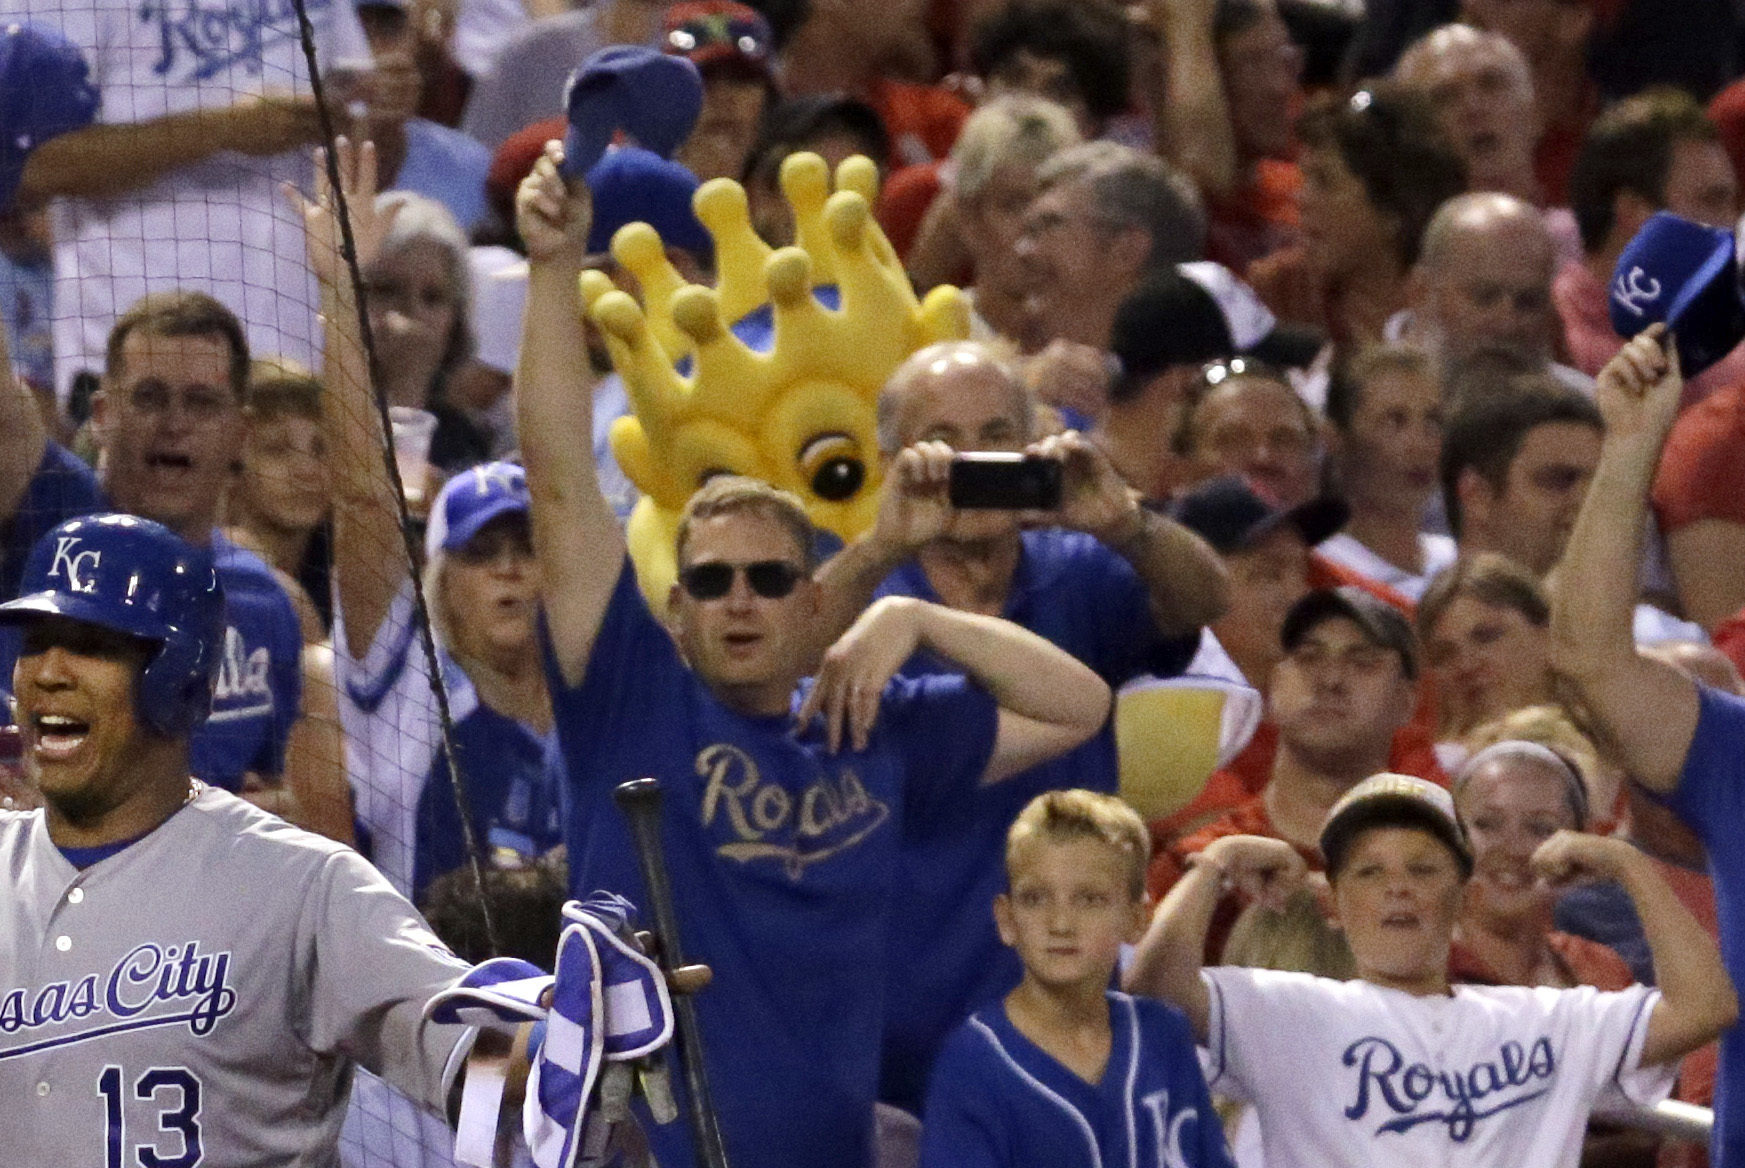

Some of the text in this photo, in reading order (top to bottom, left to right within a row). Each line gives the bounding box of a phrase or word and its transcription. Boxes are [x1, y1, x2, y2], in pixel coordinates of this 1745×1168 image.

[1614, 265, 1661, 316] KC
[47, 537, 102, 592] KC
[105, 939, 238, 1038] City
[1342, 1036, 1555, 1143] Royals
